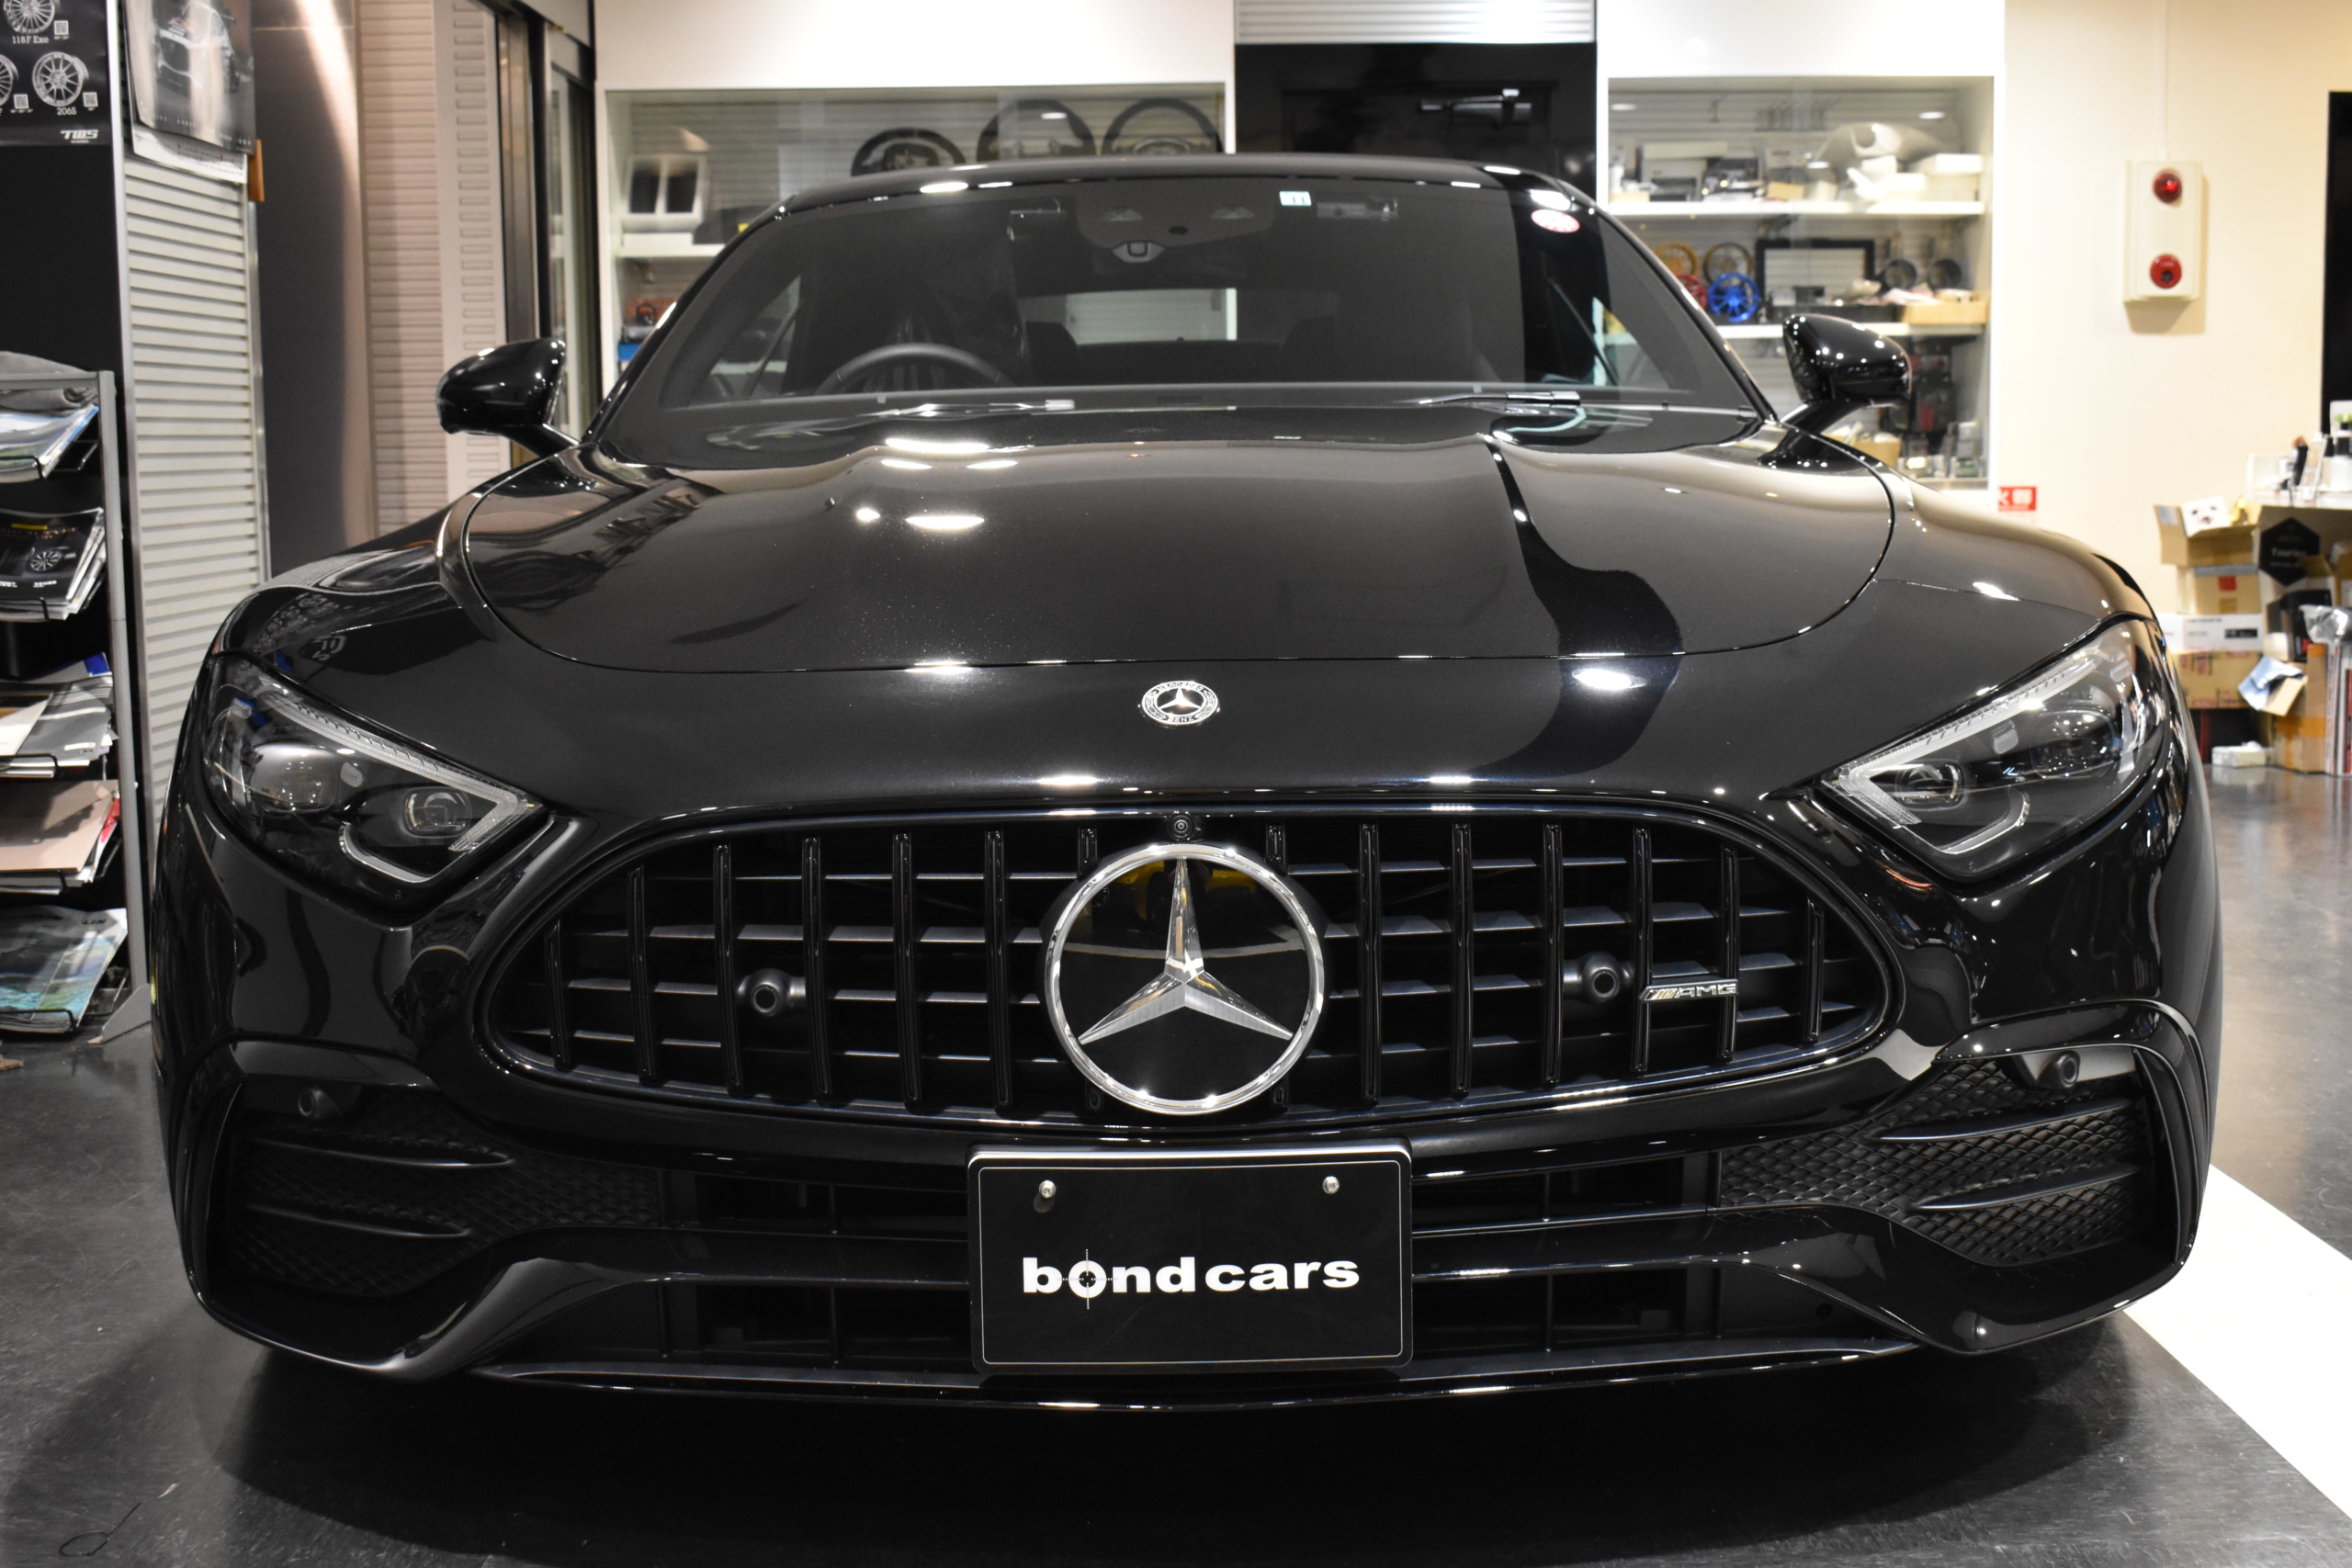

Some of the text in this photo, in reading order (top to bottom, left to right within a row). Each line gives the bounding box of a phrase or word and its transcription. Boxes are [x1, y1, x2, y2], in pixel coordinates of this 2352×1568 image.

[12, 35, 31, 44] 118F
[56, 107, 77, 116] 206S
[60, 129, 98, 140] TWS
[1674, 983, 1737, 998] AMG
[1022, 1256, 1361, 1299] bond cars
